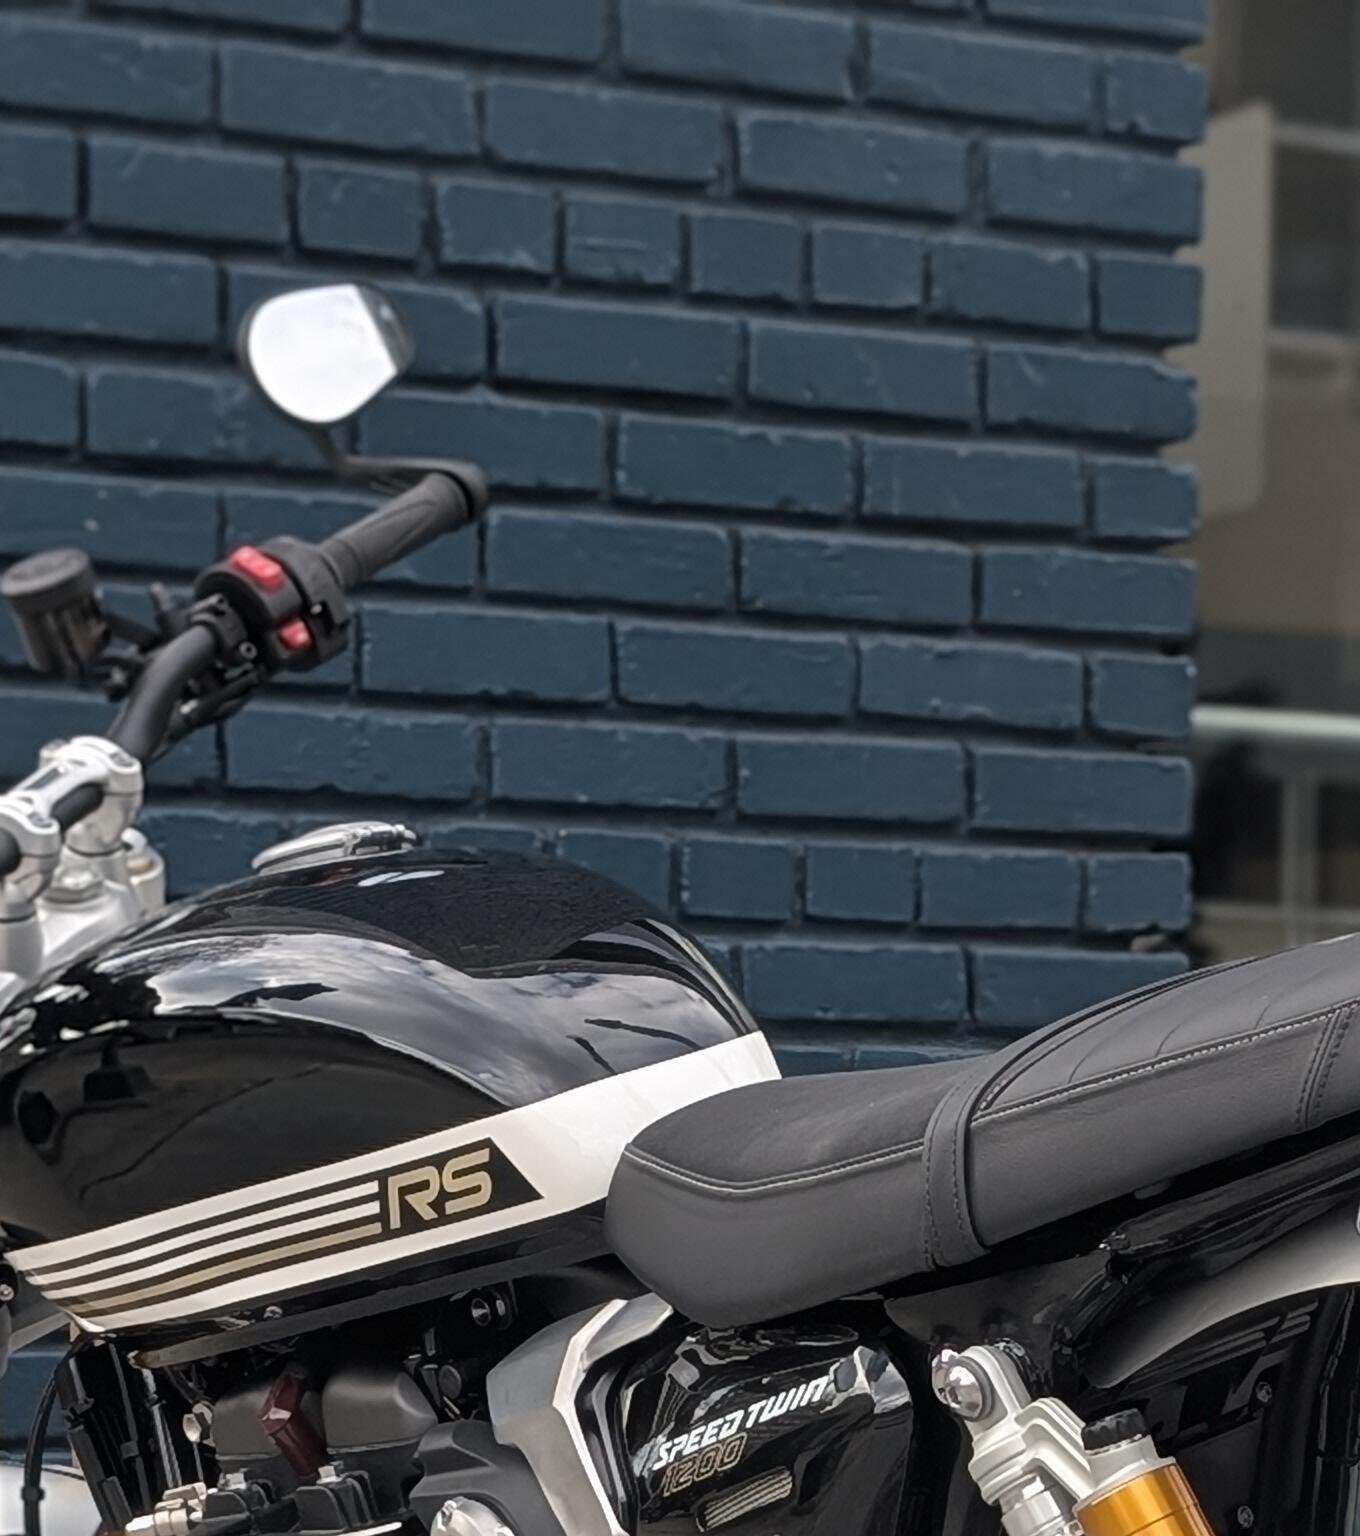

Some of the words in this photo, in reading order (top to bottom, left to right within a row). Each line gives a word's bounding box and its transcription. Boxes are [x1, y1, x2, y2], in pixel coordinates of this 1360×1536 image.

[387, 1147, 493, 1230] RS
[652, 1409, 745, 1471] SPEED
[744, 1375, 829, 1429] TWIN
[662, 1431, 749, 1498] 1200
